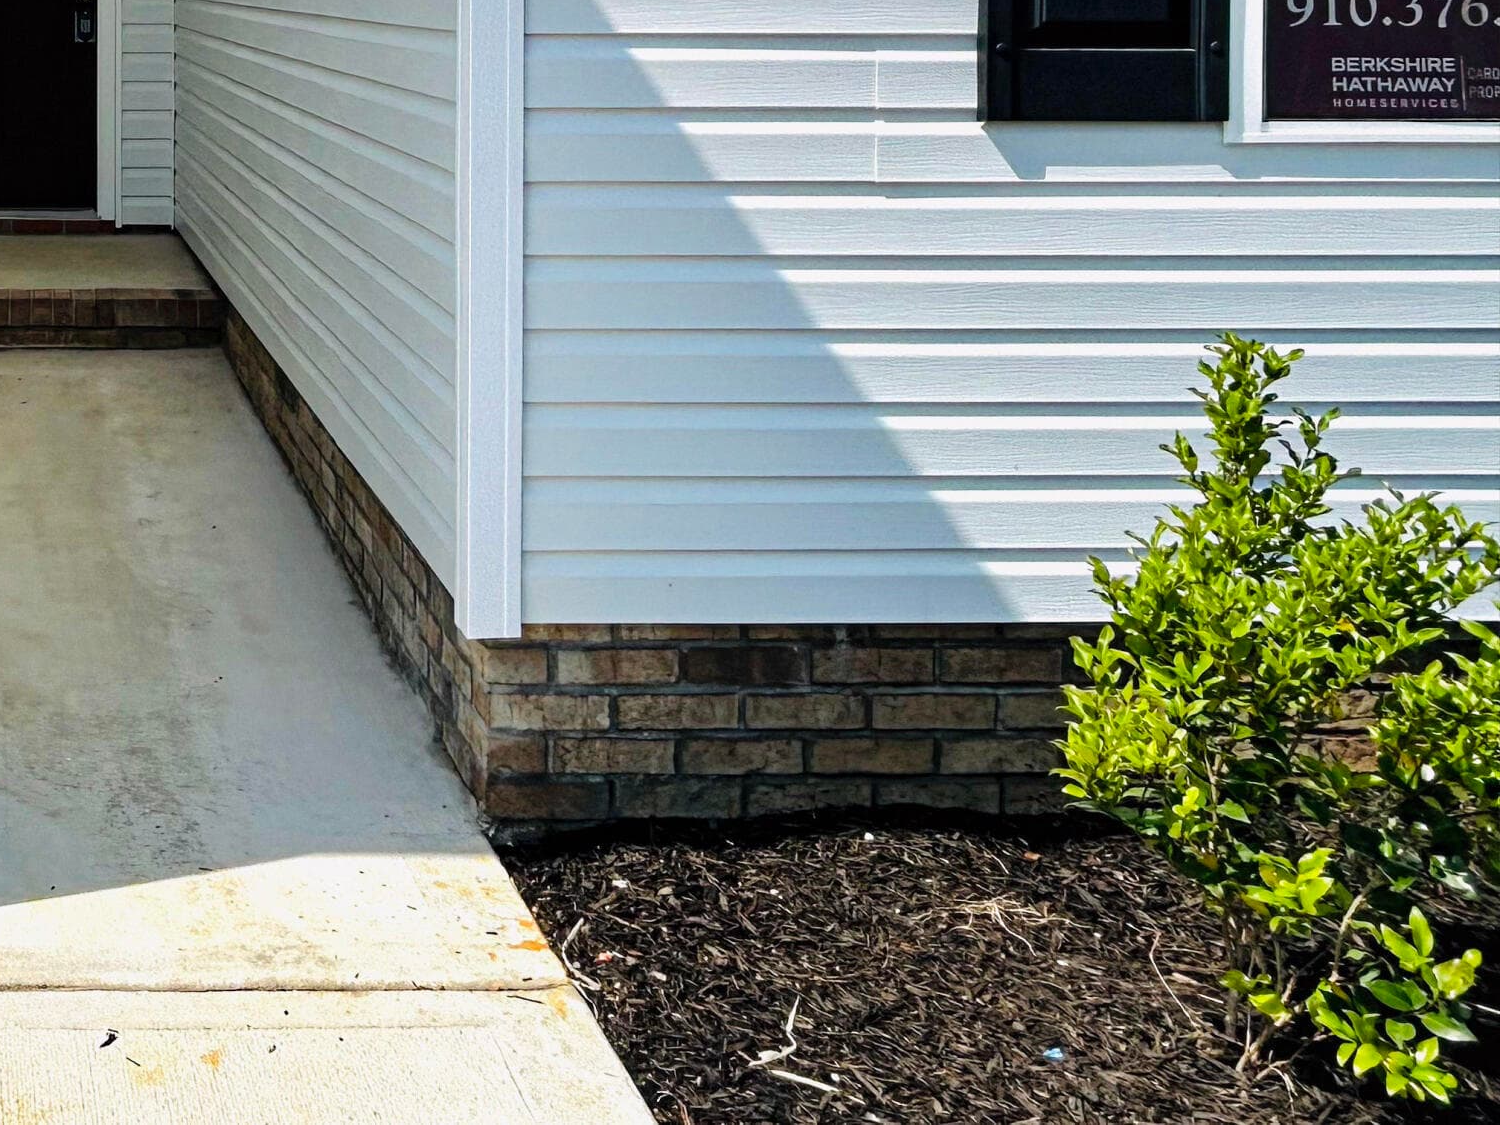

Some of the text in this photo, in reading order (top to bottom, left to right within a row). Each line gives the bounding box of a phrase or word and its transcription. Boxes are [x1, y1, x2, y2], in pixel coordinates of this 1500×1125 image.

[1331, 57, 1456, 72] BERKSHIRE
[1332, 76, 1456, 92] HATHAWAY
[1333, 98, 1459, 108] HOMESERVICES
